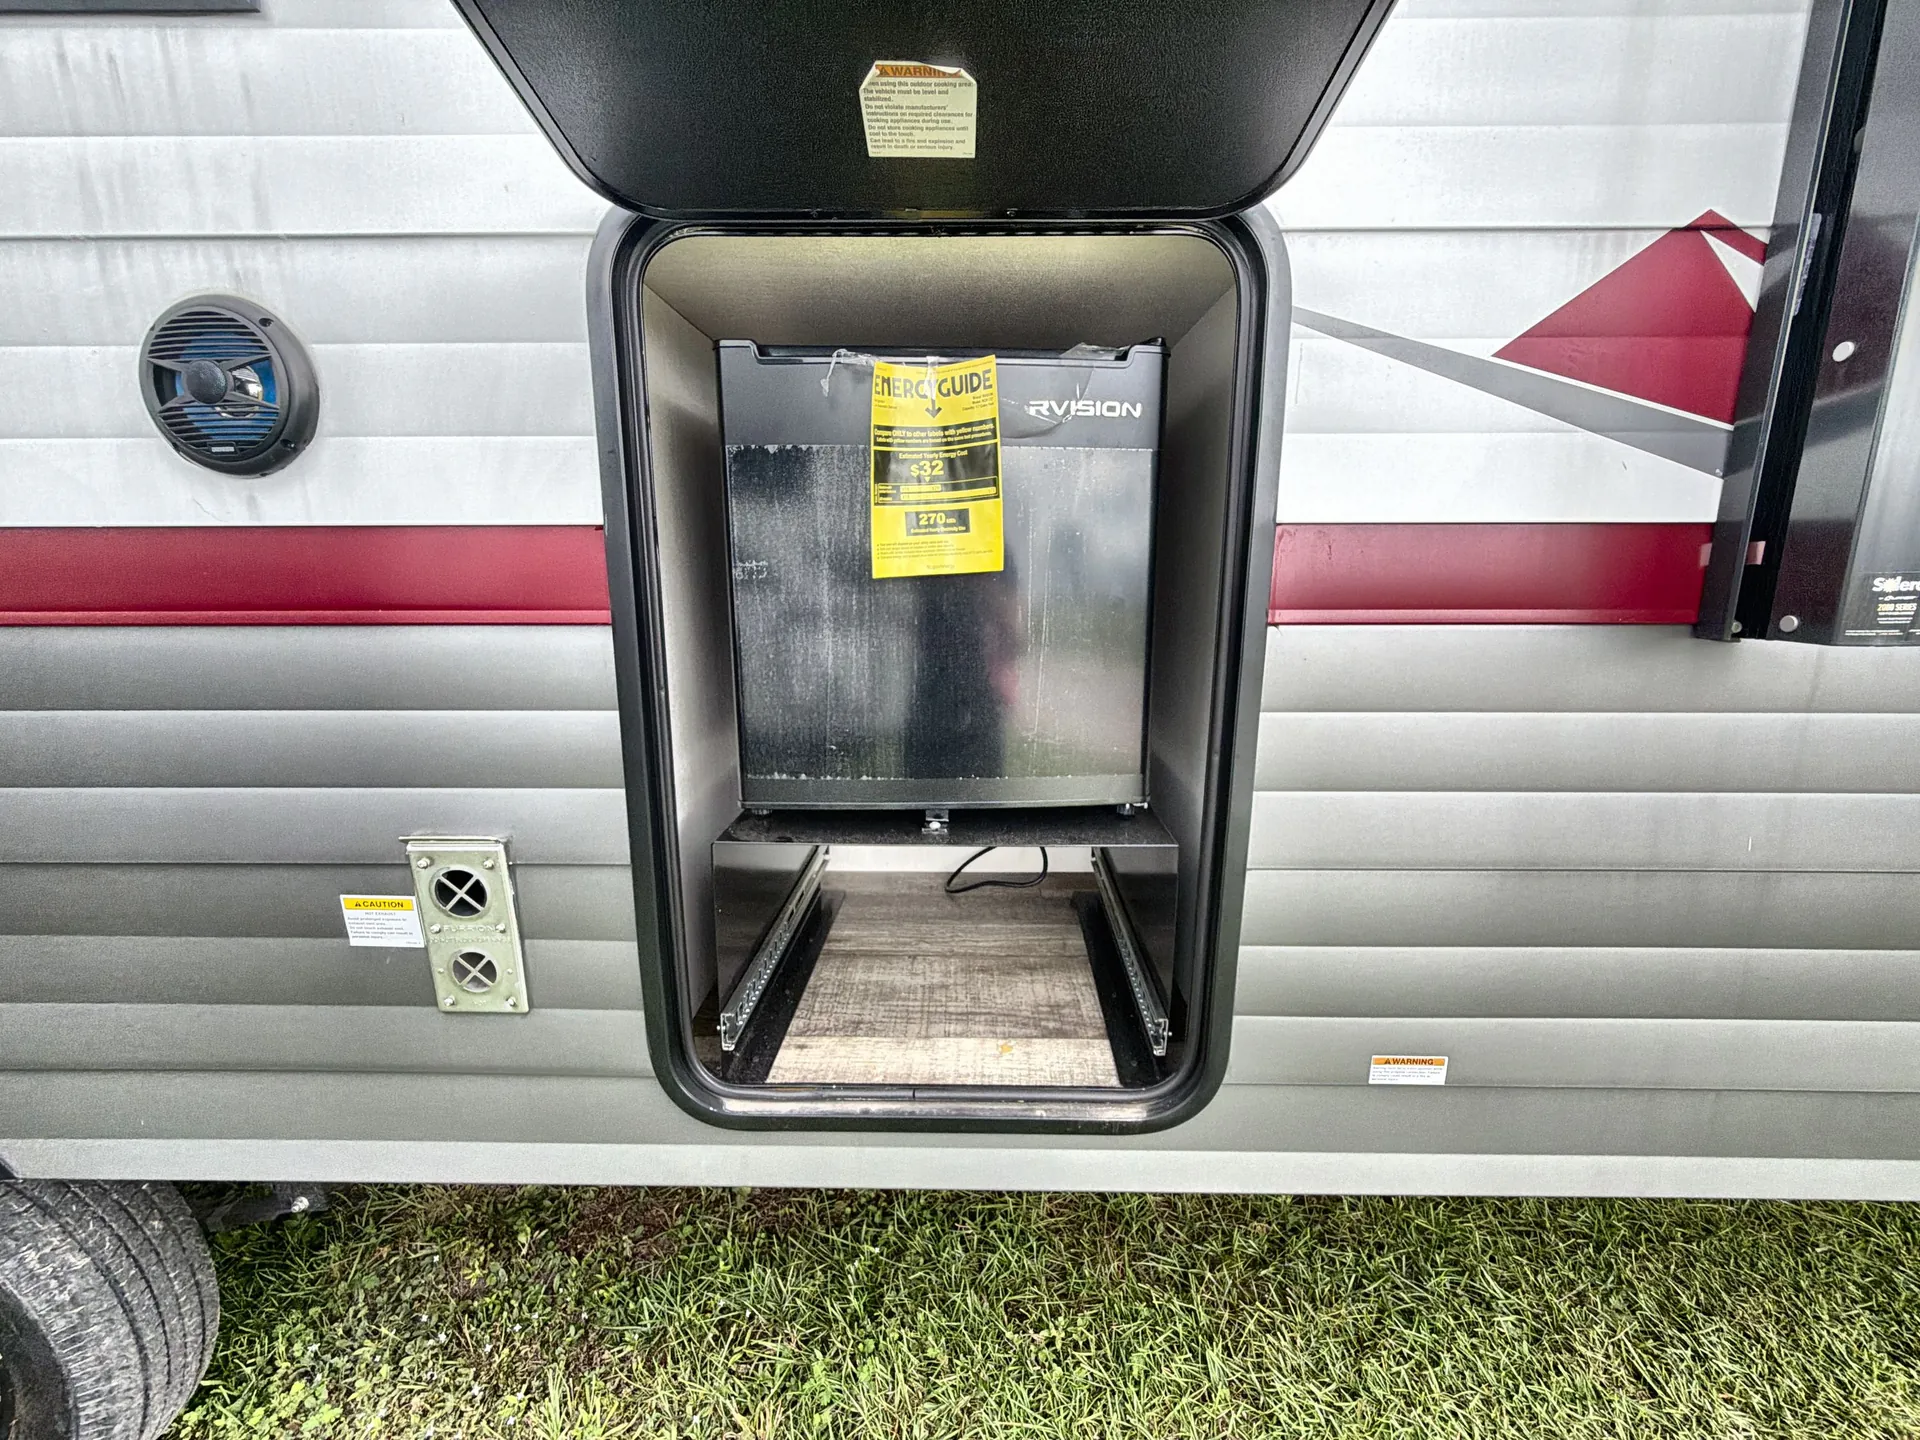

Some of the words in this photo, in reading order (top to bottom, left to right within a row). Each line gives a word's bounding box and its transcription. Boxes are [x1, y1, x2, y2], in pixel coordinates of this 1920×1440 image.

[1029, 400, 1142, 418] RVISION
[957, 426, 971, 434] yellow
[924, 452, 938, 460] Yearly
[910, 460, 944, 477] $32
[918, 513, 946, 525] 270
